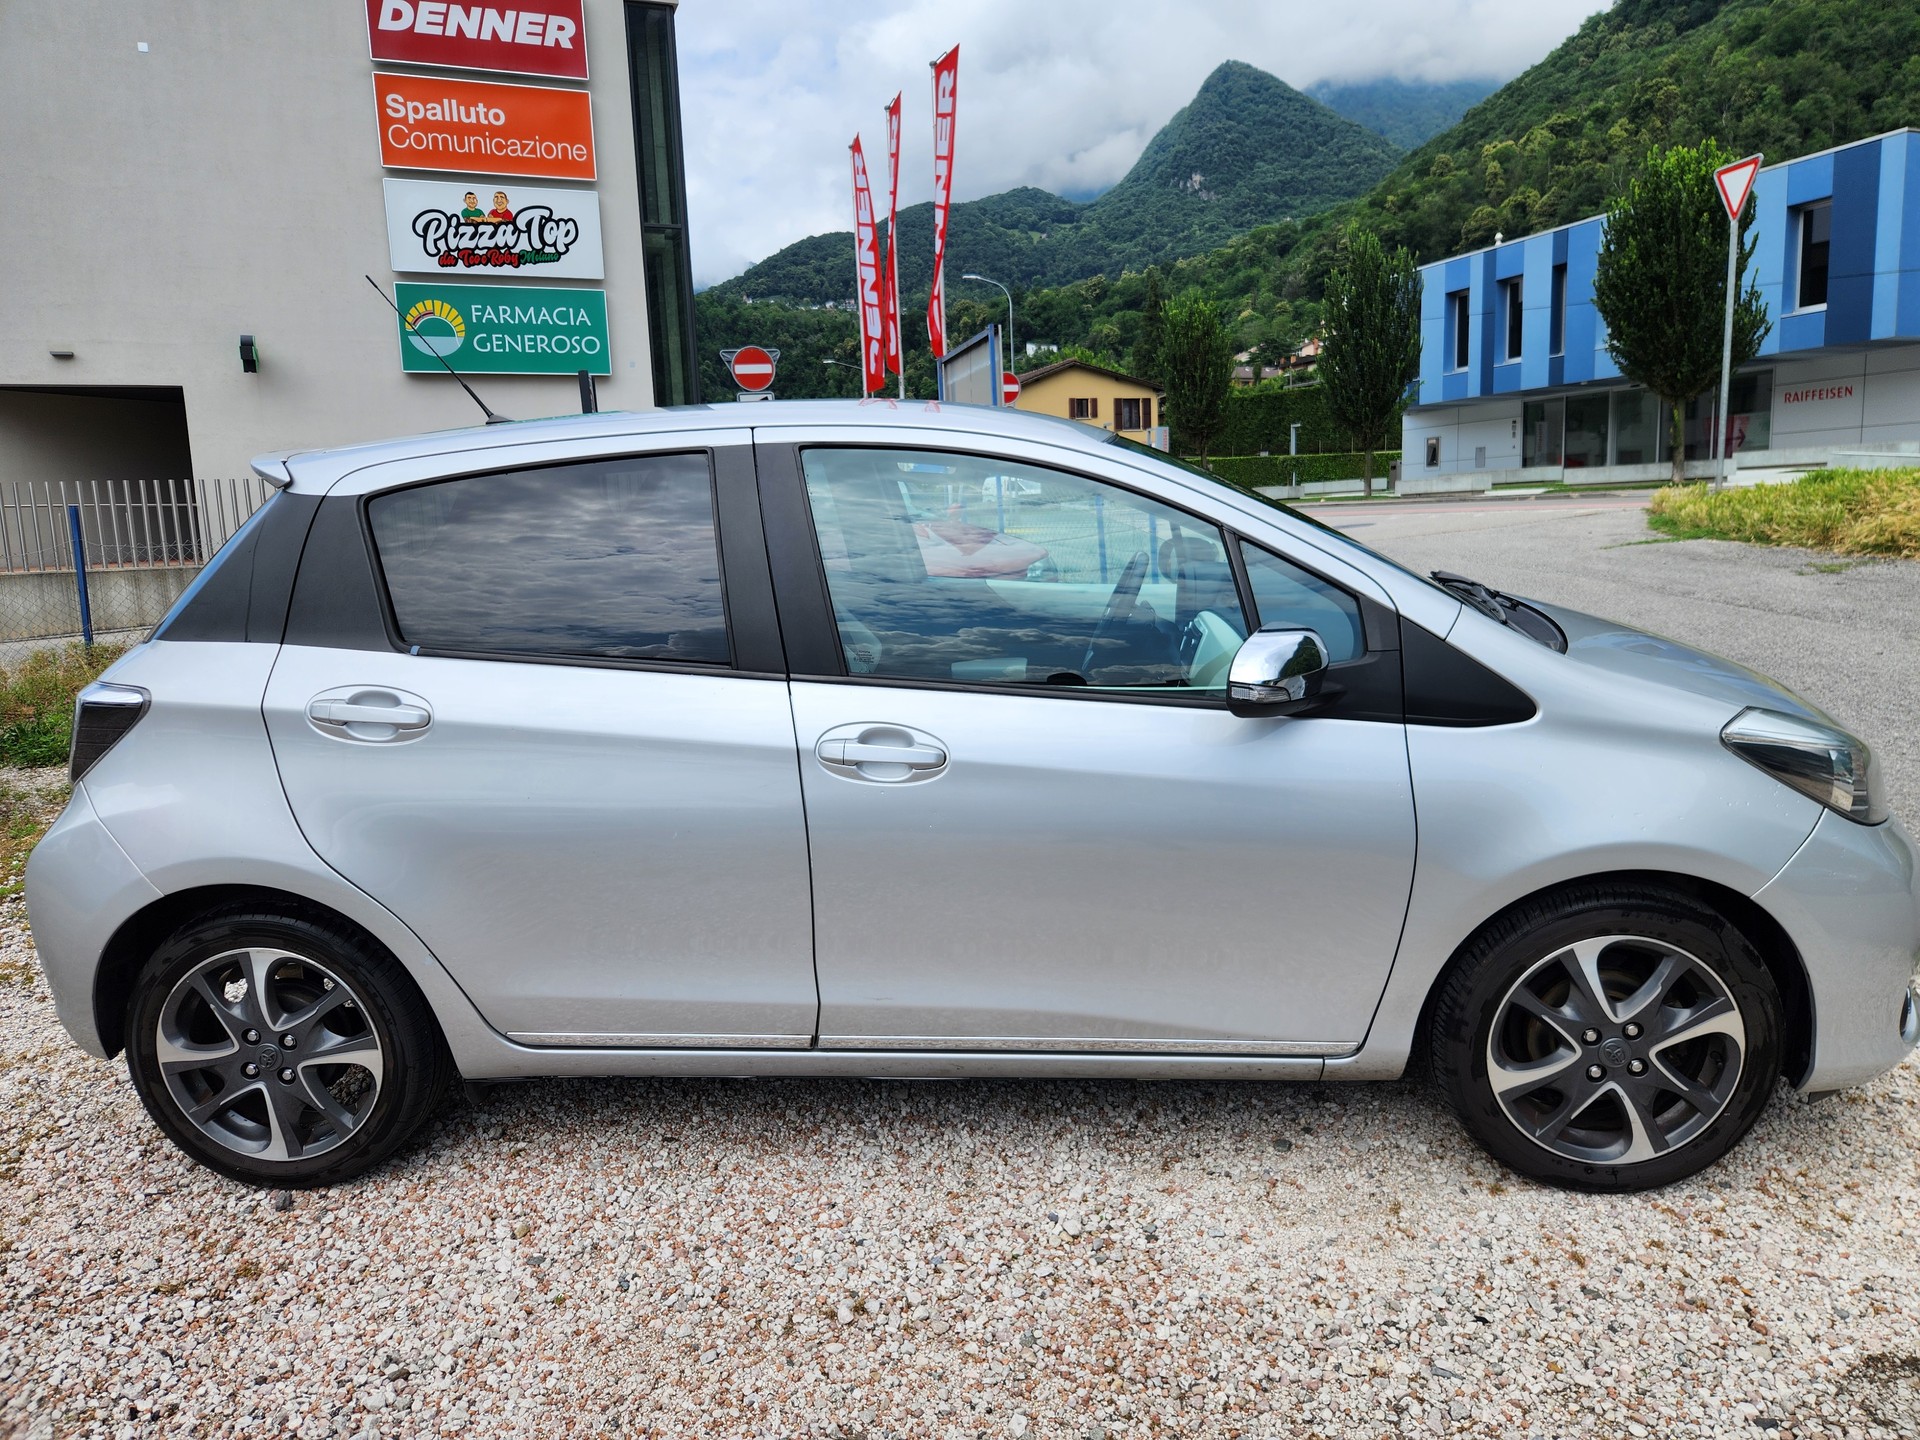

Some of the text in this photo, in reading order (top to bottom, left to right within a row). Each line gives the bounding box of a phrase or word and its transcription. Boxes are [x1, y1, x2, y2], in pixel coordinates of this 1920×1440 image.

[378, 0, 576, 49] DENNER
[385, 93, 506, 126] Spalluto
[388, 124, 587, 162] Comunicazione
[413, 205, 578, 257] Pizza Top
[439, 250, 457, 266] da
[487, 248, 520, 267] Roby
[471, 304, 592, 326] FARMACIA
[473, 333, 601, 355] GENEROSO
[1784, 385, 1853, 403] RAIFFEISEN
